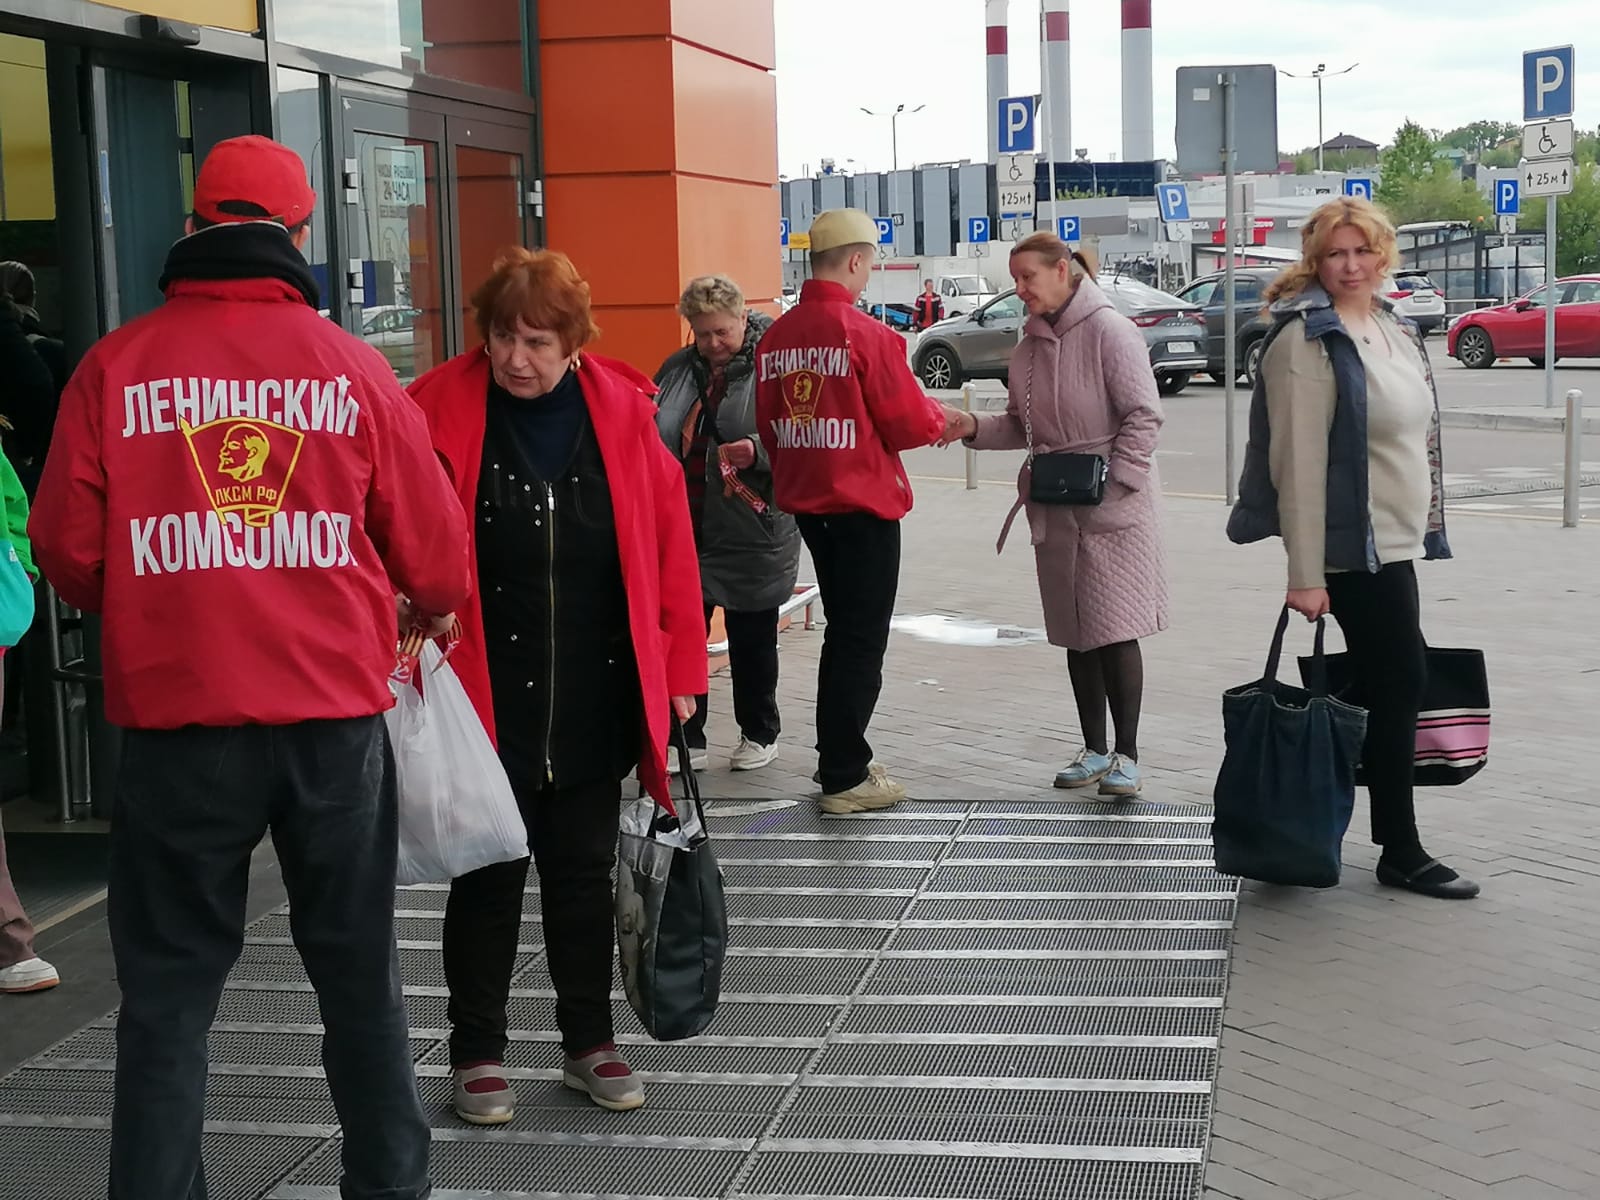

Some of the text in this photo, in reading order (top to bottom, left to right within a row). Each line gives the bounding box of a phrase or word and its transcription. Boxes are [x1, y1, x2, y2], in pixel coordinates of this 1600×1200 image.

[1536, 55, 1565, 112] P
[1007, 102, 1028, 148] P
[1166, 188, 1182, 216] P
[1501, 183, 1515, 210] P
[878, 221, 890, 242] P
[973, 220, 985, 241] P
[1063, 219, 1076, 239] P
[122, 374, 360, 438] ЛЕНИНСКИЙ
[215, 485, 278, 506] ЛКСМ РФ
[130, 510, 359, 577] КОМСОМОЛ
